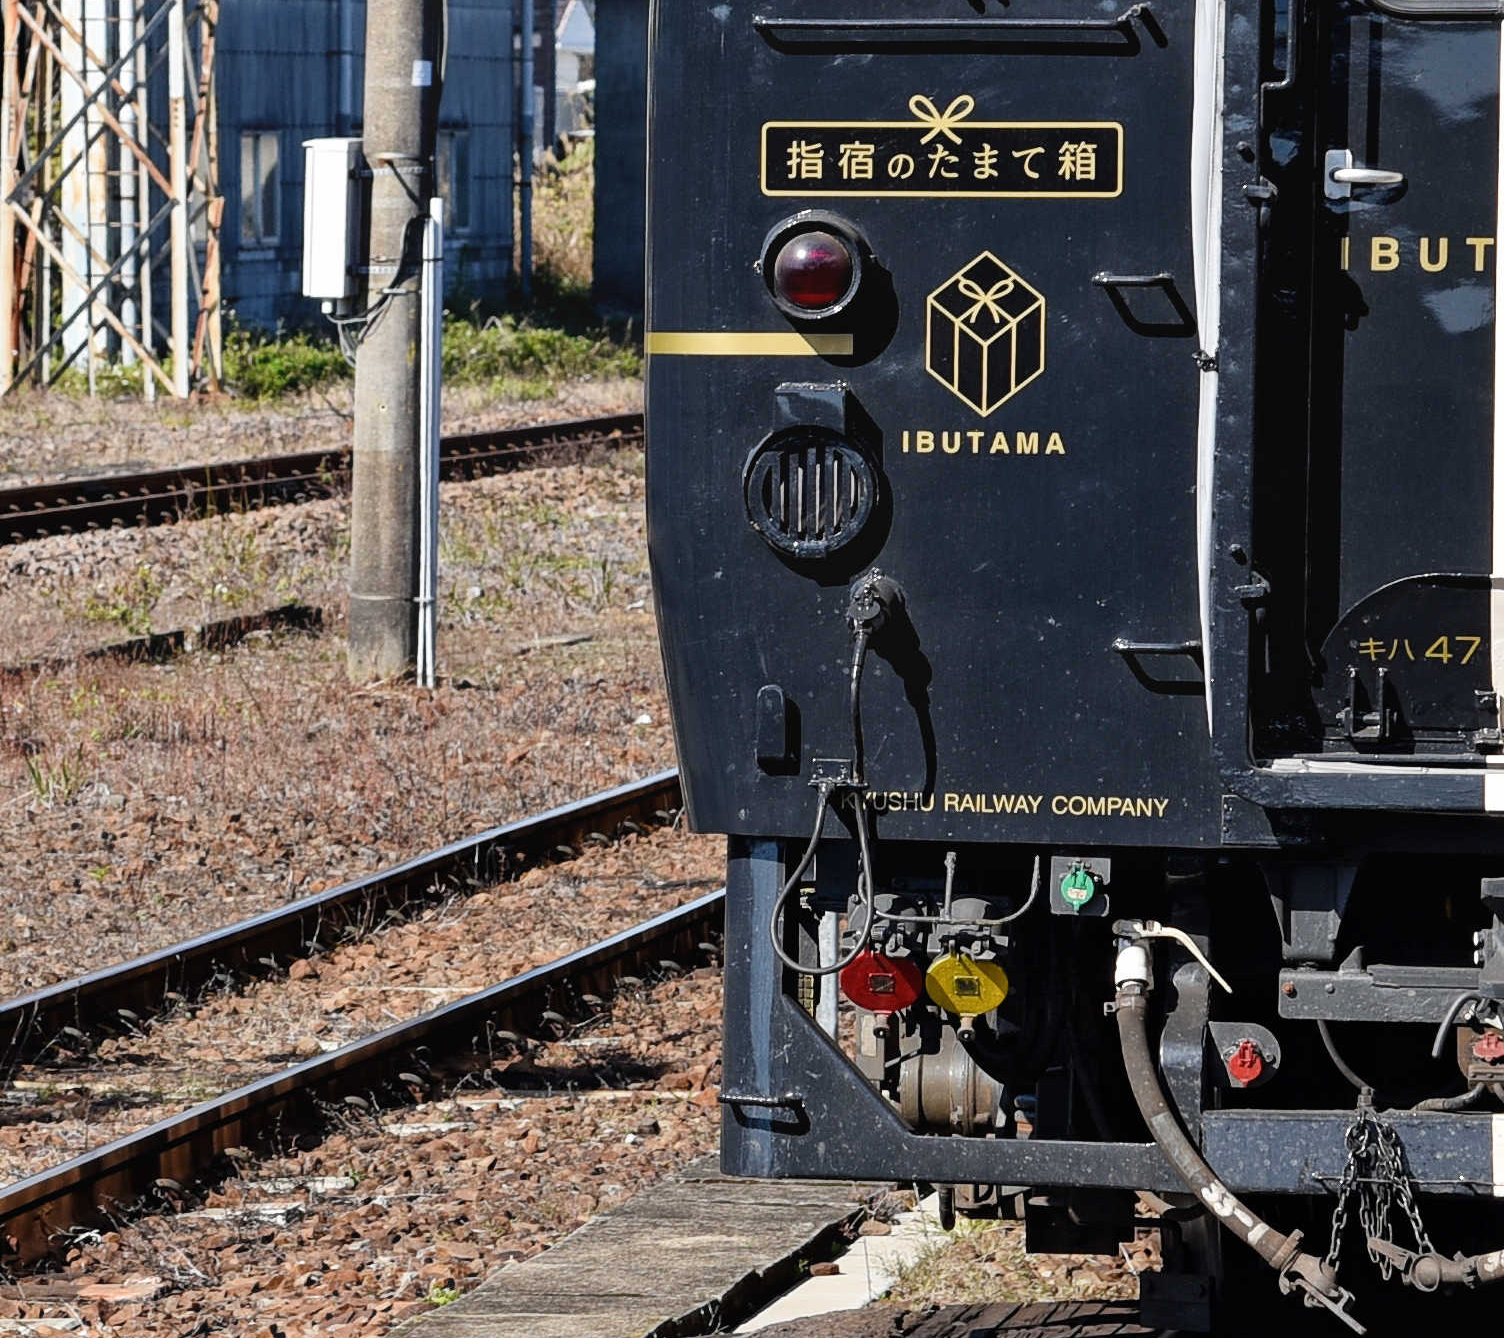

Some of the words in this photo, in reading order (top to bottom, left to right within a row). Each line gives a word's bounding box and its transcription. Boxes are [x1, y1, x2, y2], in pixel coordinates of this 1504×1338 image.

[786, 140, 1098, 183] 指宿のたまて箱
[902, 431, 1066, 455] IBUTAMA
[944, 793, 1043, 814] RAILWAY
[1052, 795, 1168, 818] COMPANY
